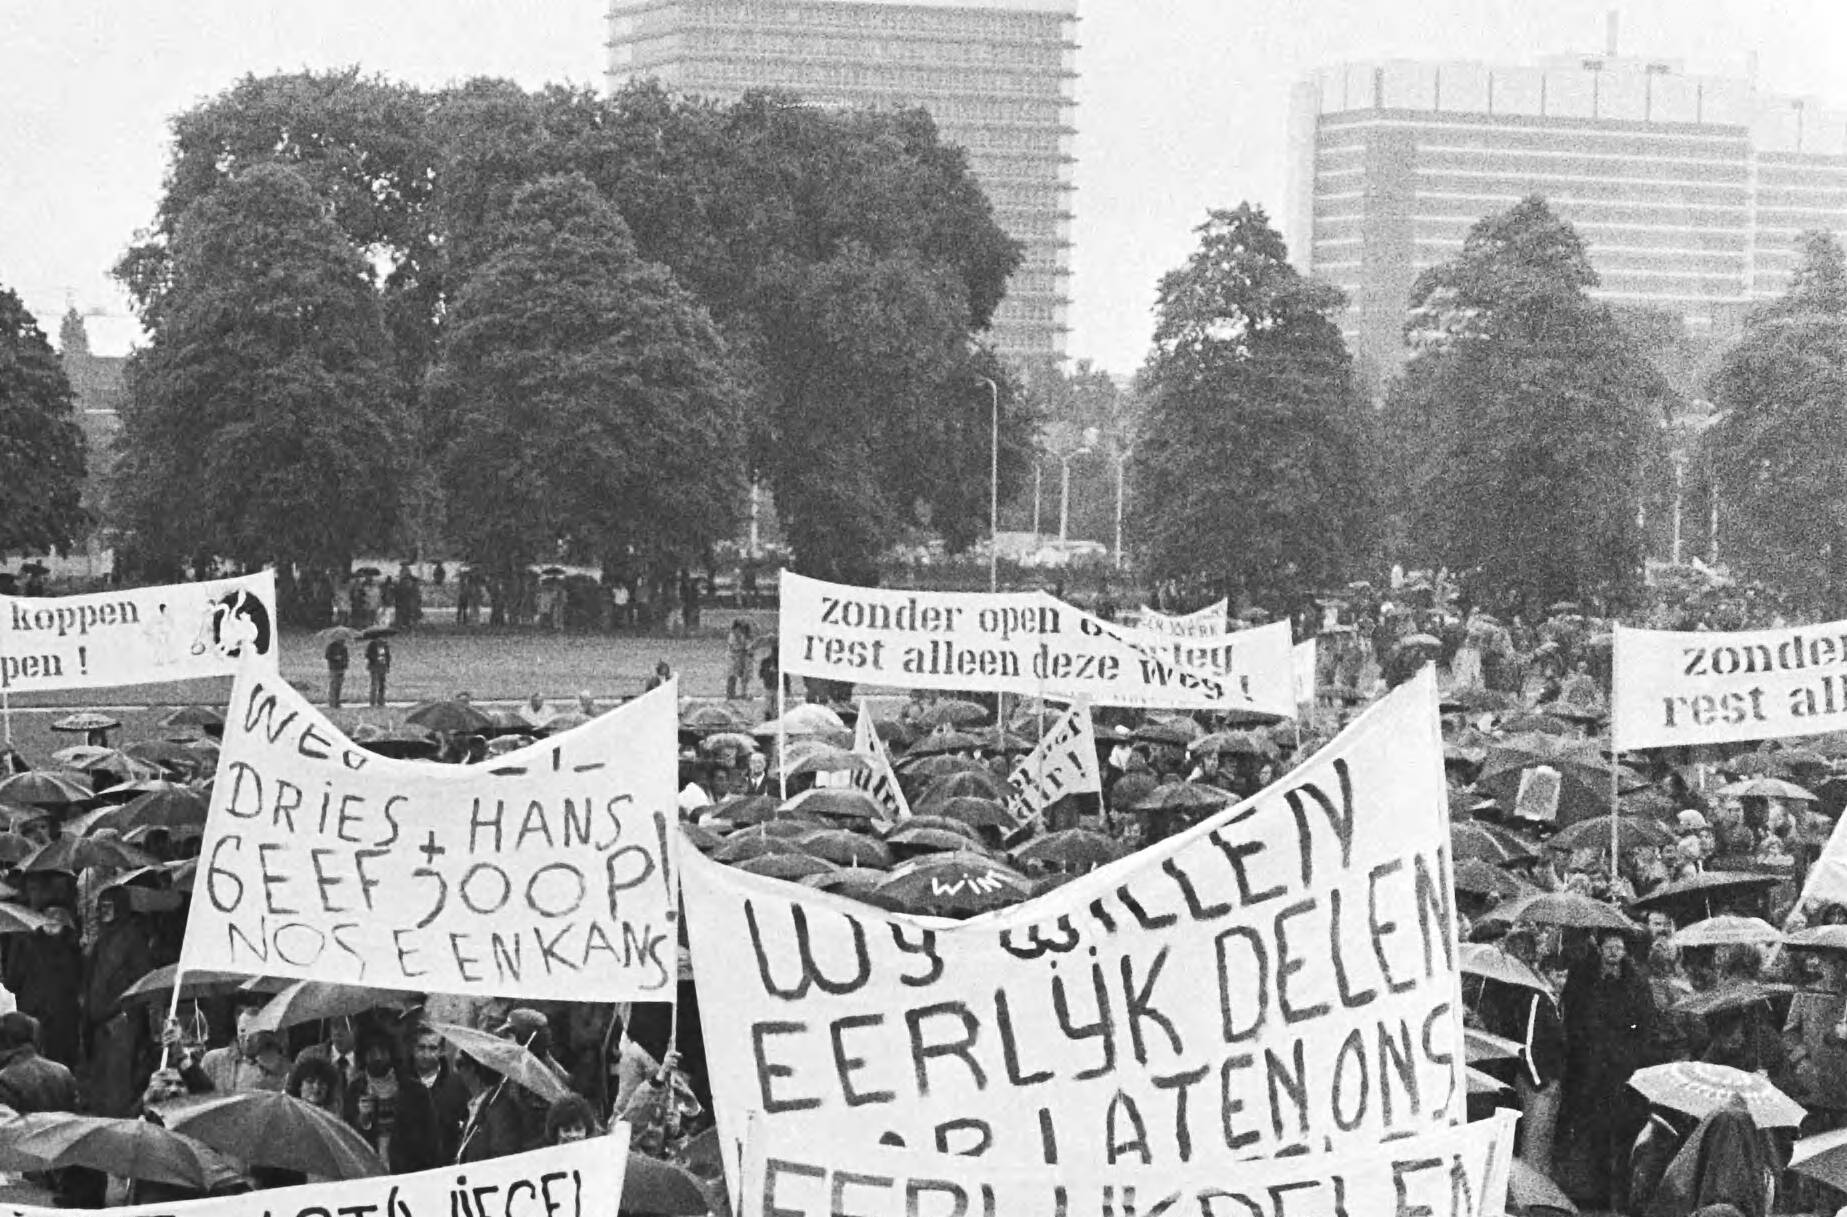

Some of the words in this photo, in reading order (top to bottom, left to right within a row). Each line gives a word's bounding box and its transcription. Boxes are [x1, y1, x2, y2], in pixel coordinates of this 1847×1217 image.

[11, 600, 141, 637] koppen
[820, 597, 963, 633] zonder
[978, 603, 1060, 638] open
[803, 634, 885, 676] rest
[903, 640, 1020, 679] alleen
[1032, 643, 1119, 681] deze
[1663, 686, 1766, 728] rest
[470, 793, 633, 854] HANS
[206, 834, 392, 915] GEEF
[1216, 845, 1453, 1044] DELEN
[1331, 1002, 1456, 1133] ONS
